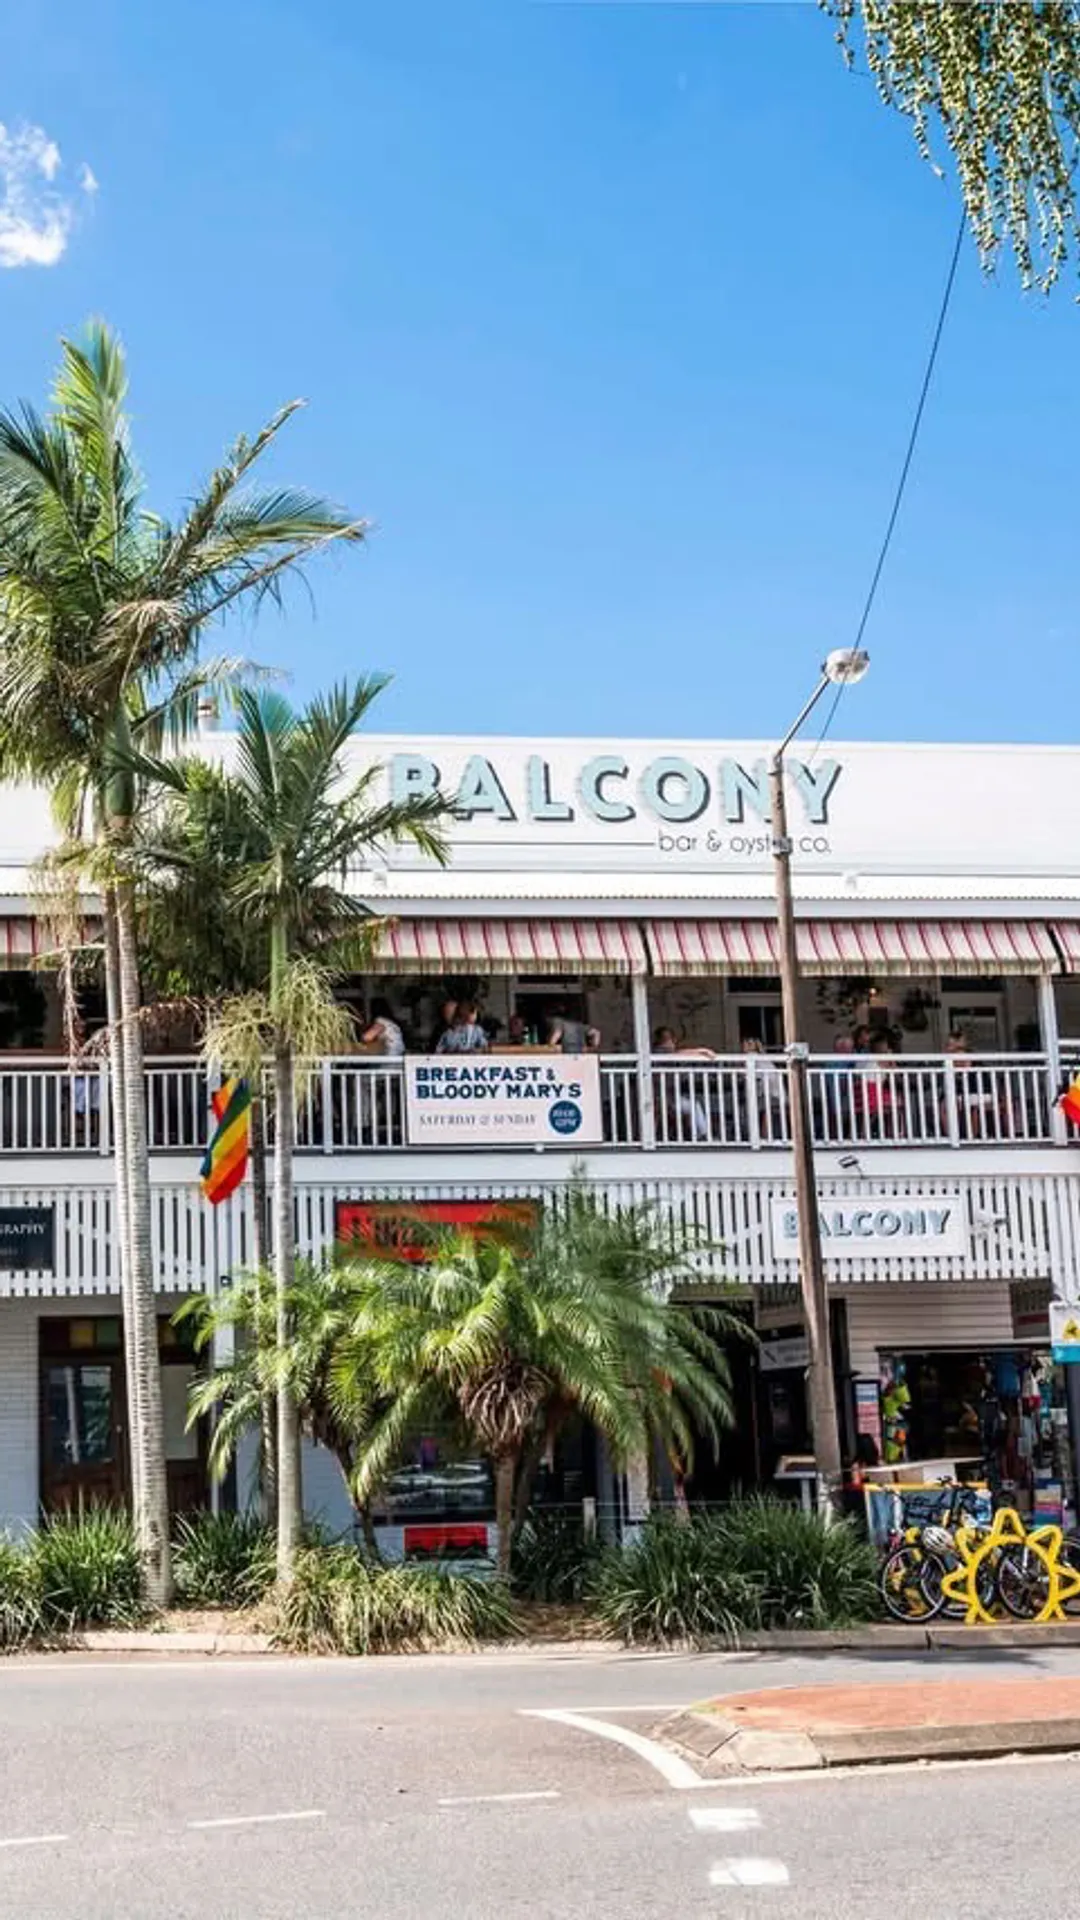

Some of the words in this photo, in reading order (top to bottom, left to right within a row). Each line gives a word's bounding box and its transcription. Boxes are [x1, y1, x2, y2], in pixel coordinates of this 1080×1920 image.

[388, 754, 843, 824] BALCONY
[659, 829, 697, 852] bar
[706, 829, 722, 852] &
[729, 832, 793, 854] oyst
[415, 1067, 541, 1082] BREAKFAST
[545, 1069, 556, 1081] &
[416, 1084, 499, 1099] BLOODY
[419, 1114, 476, 1125] SATURDAY
[493, 1114, 536, 1125] SUNDAY
